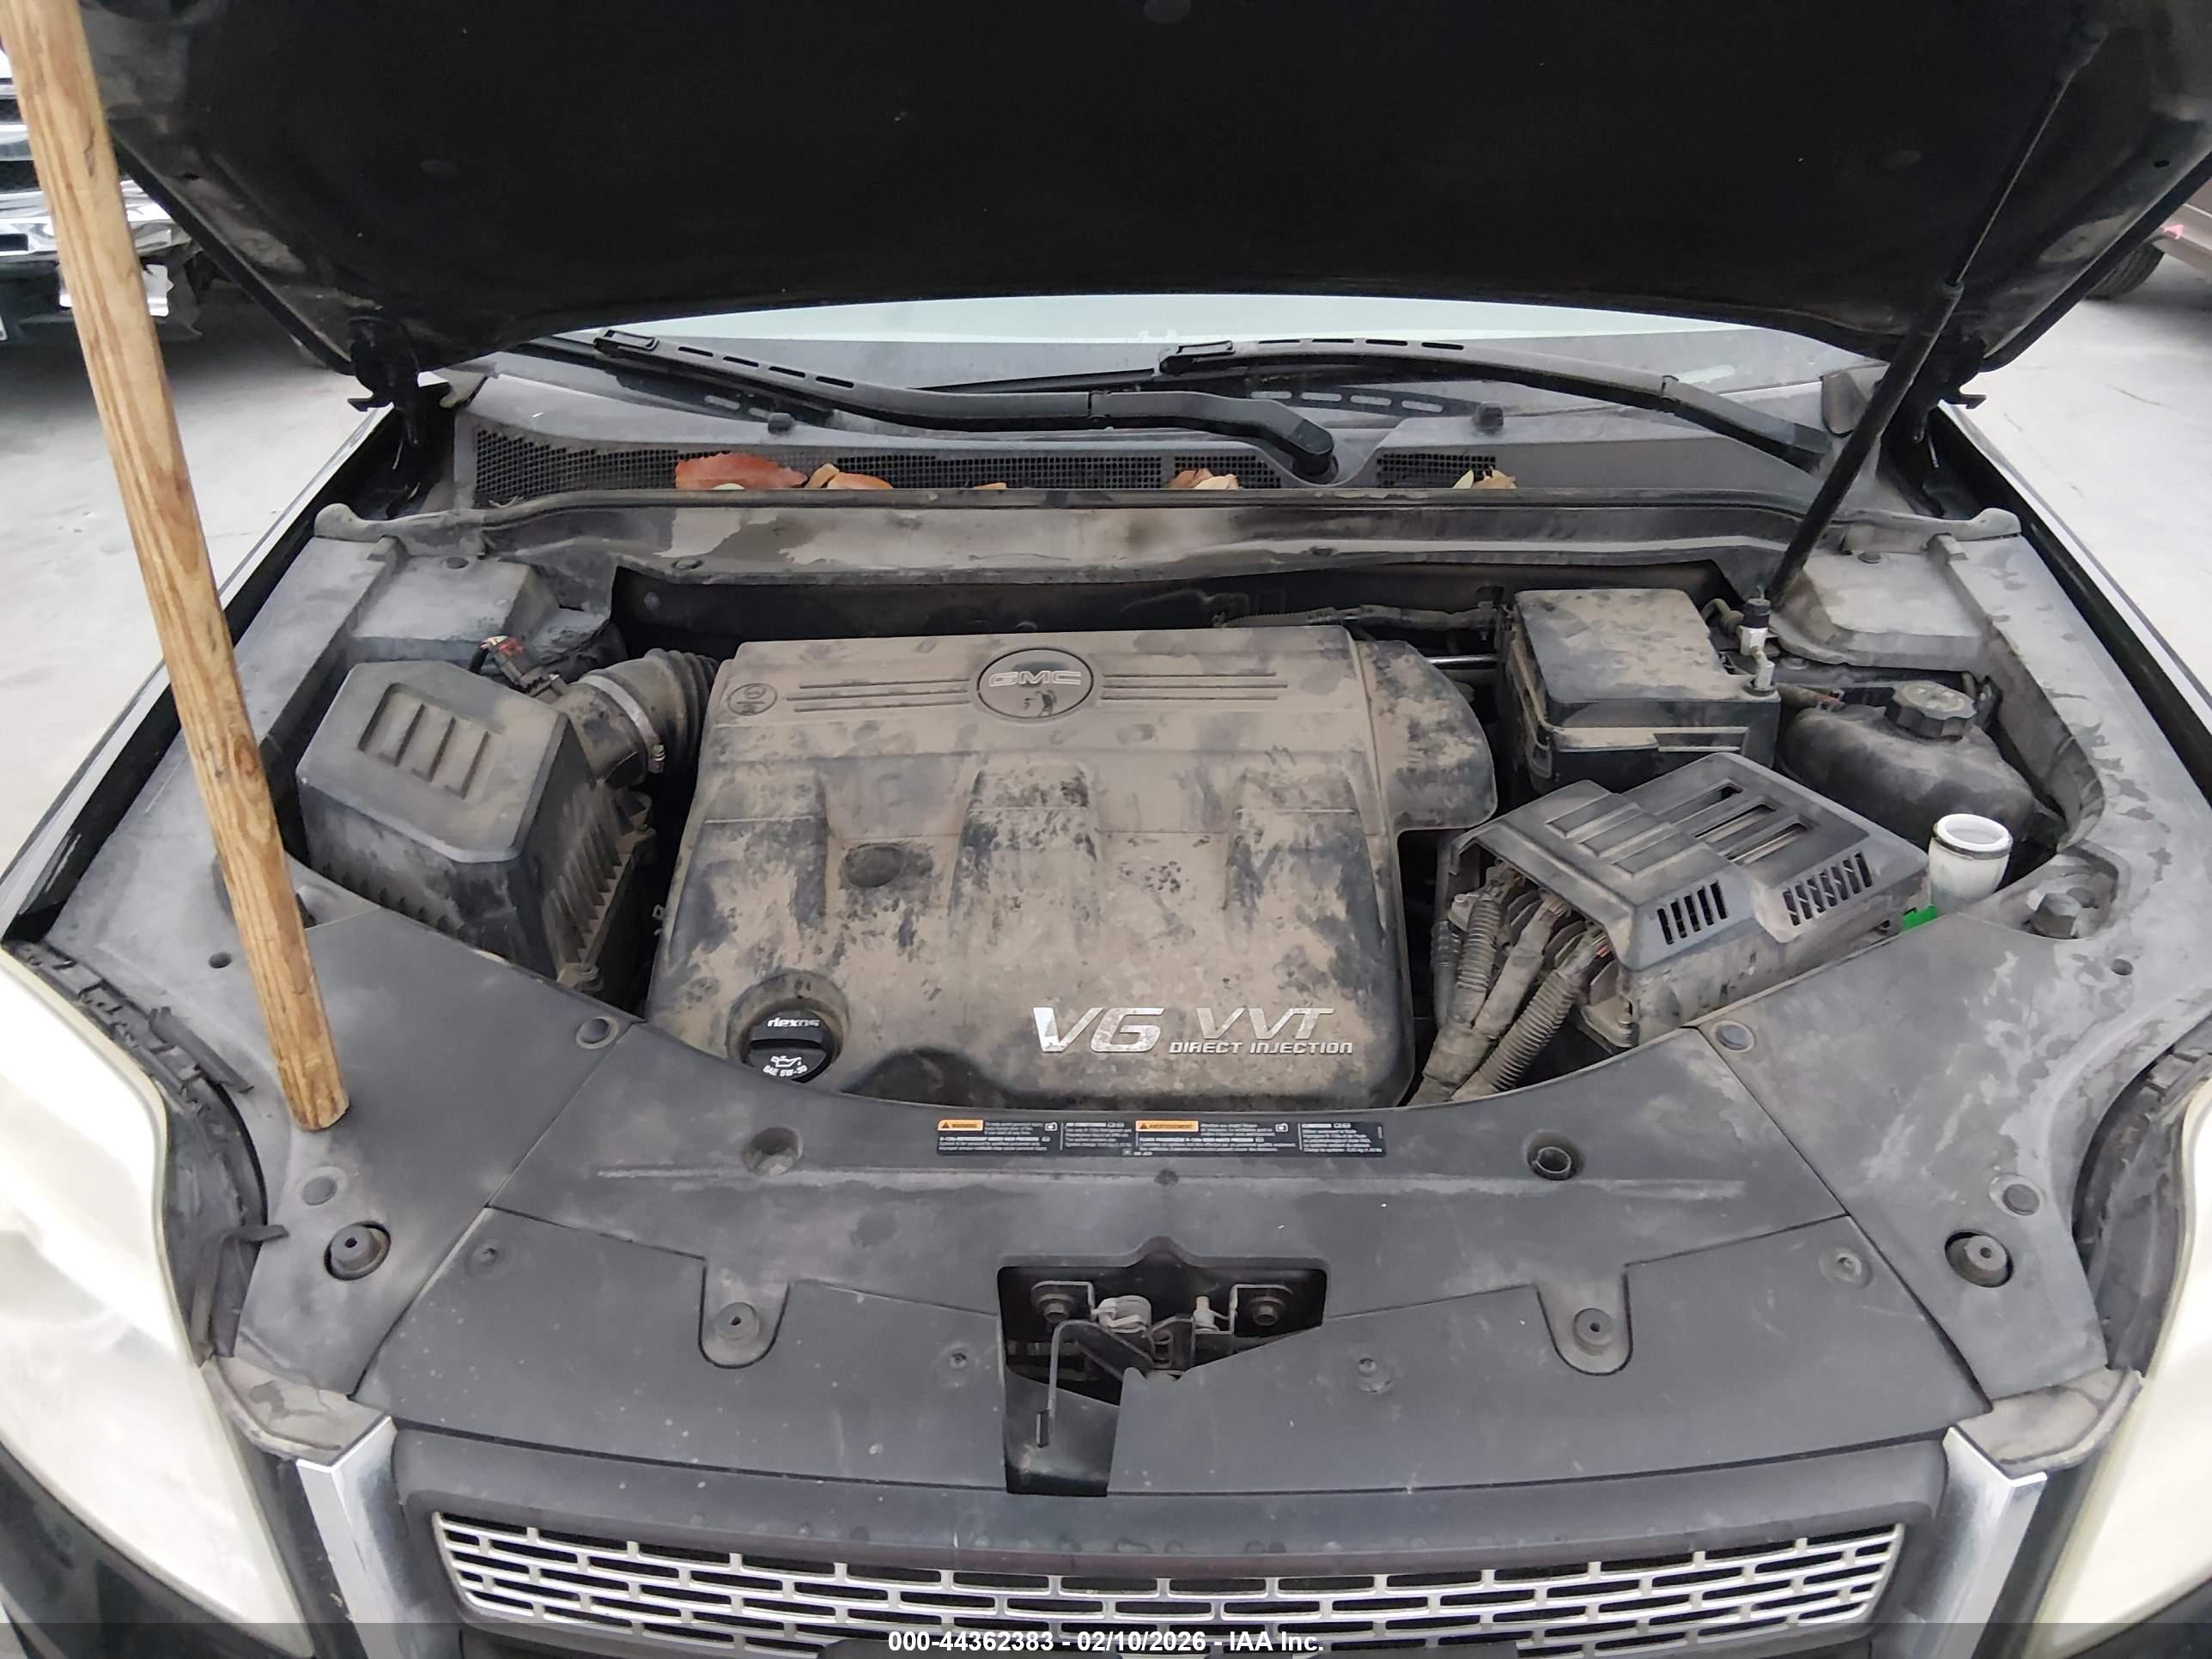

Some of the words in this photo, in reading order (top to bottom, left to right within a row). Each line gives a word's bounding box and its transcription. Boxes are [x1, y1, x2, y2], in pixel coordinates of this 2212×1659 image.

[988, 670, 1083, 688] GMC
[1032, 1006, 1166, 1054] V6
[1195, 1006, 1335, 1040] VVT
[1169, 1042, 1243, 1054] DIRECT
[1250, 1042, 1353, 1054] INJECTION
